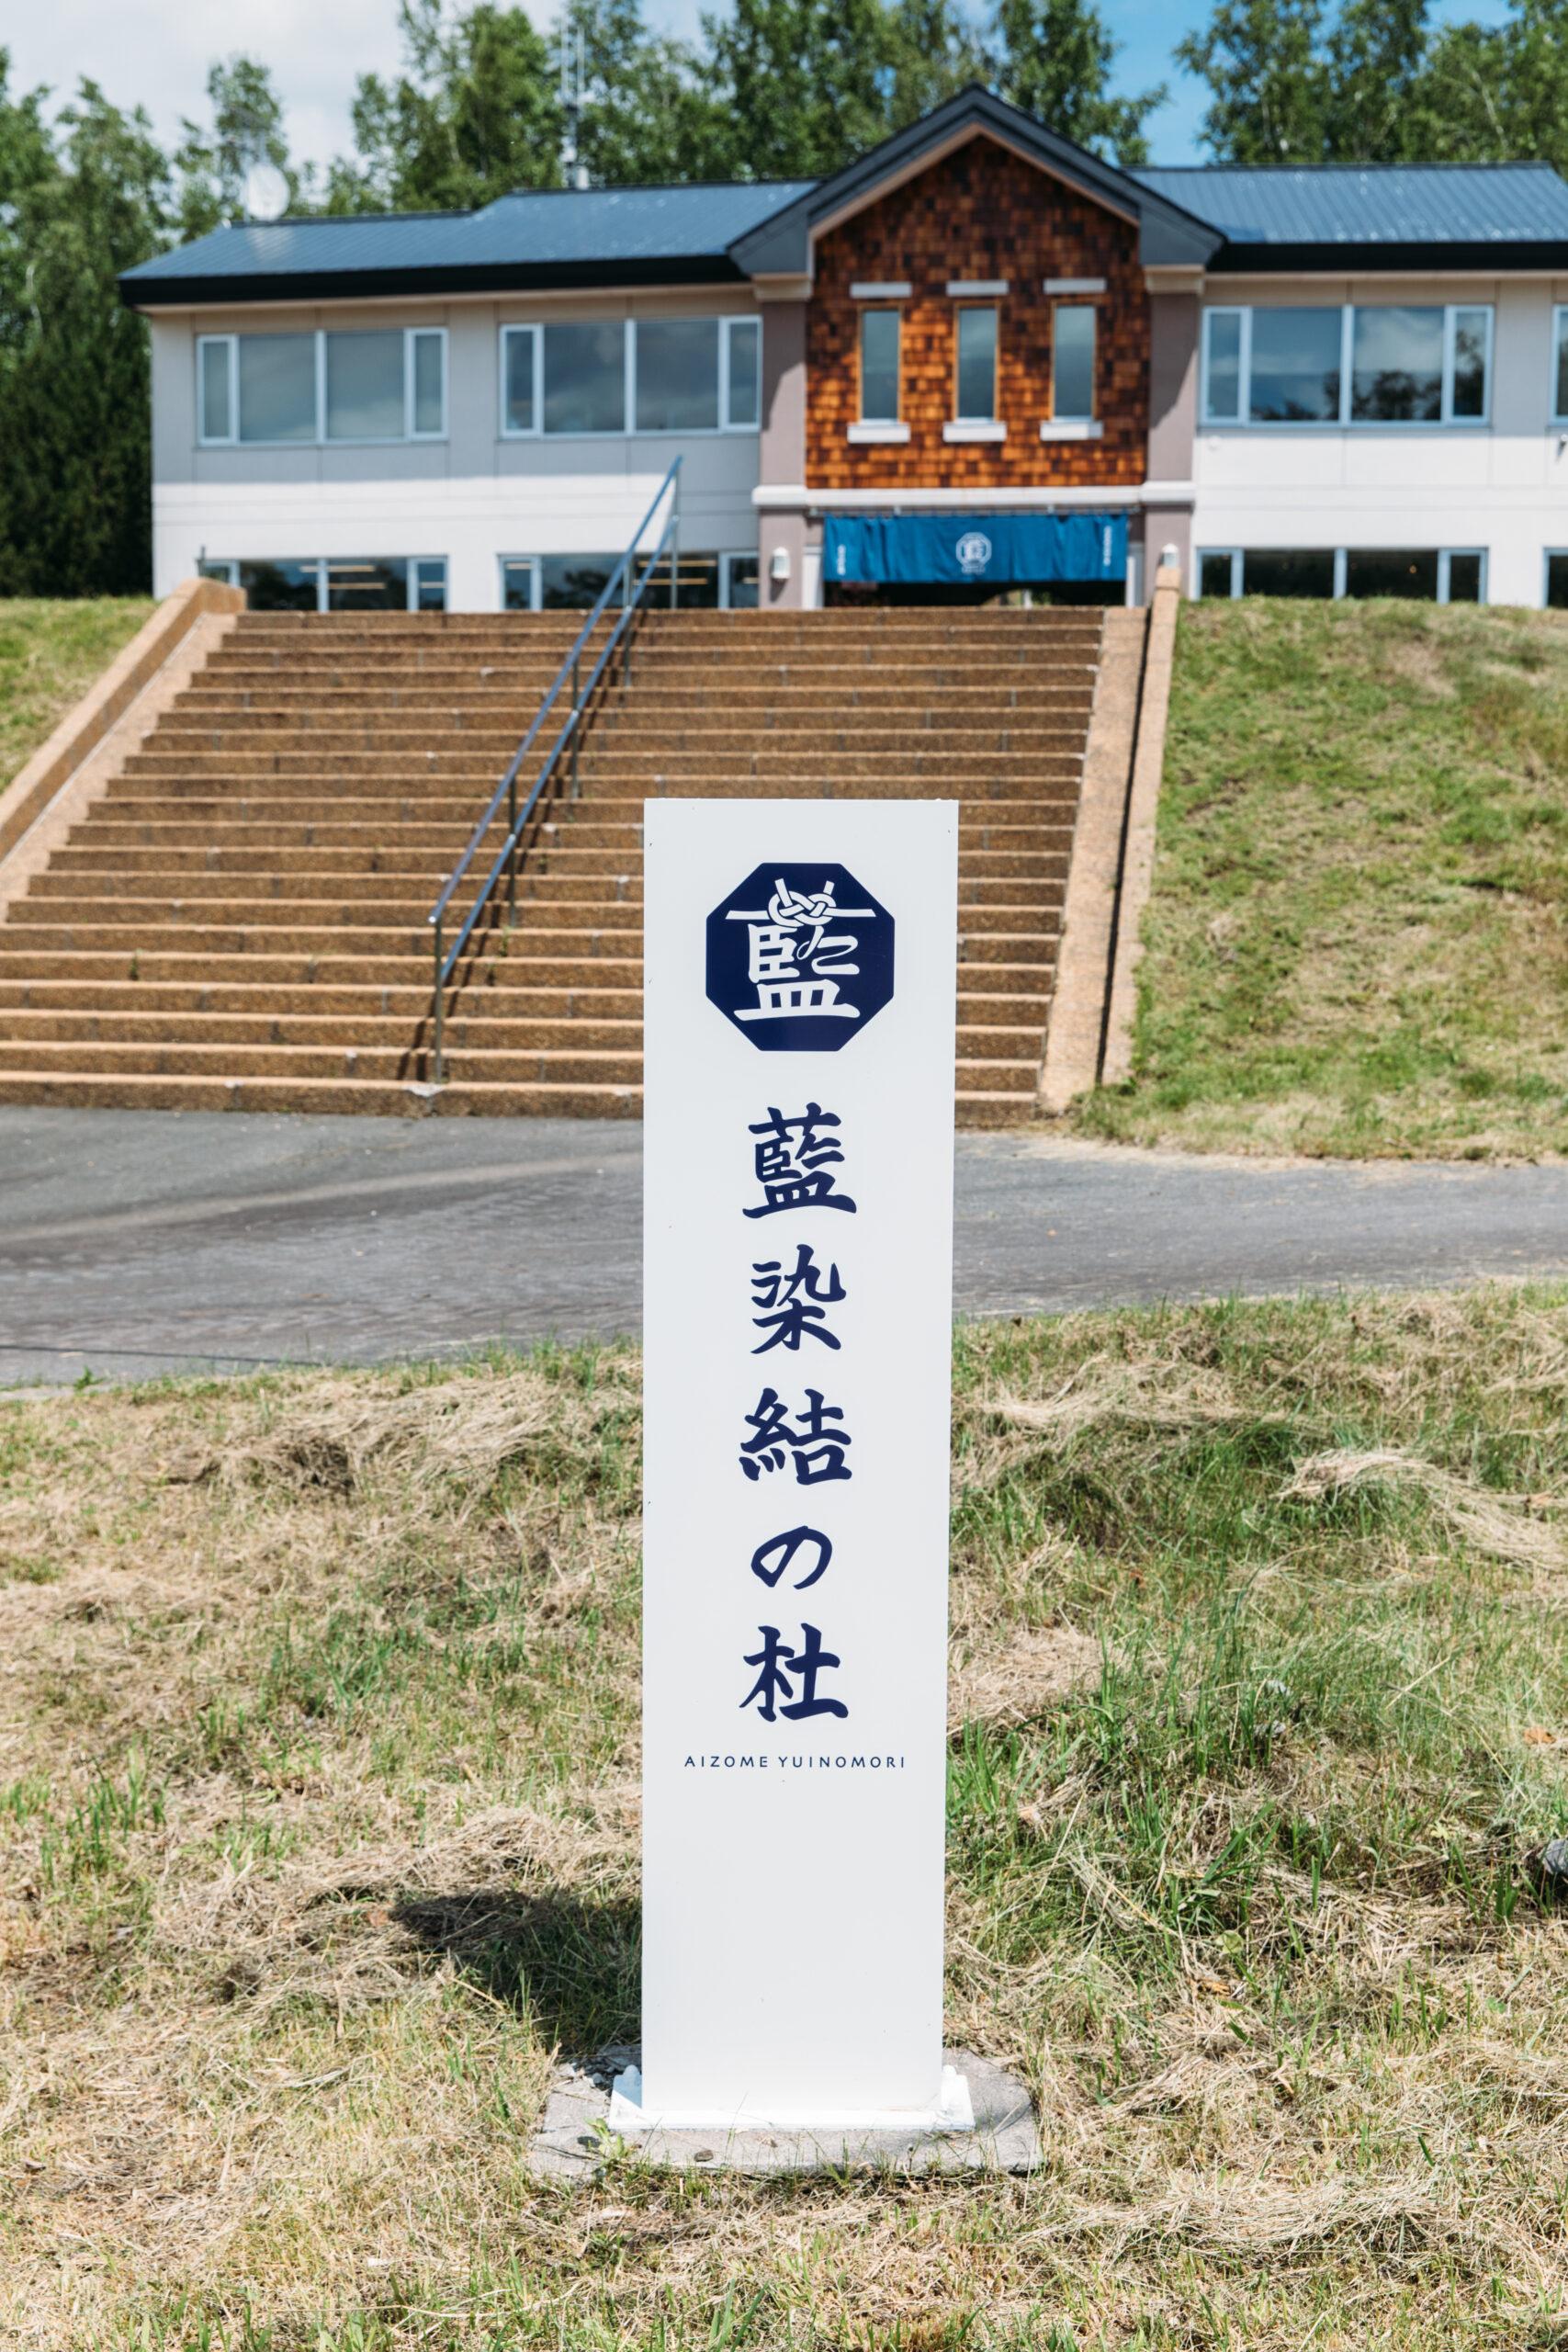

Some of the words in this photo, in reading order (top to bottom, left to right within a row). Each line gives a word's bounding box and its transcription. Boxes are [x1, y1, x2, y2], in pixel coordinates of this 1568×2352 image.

[739, 1102, 857, 1723] 藍染結の杜
[684, 1756, 768, 1769] AIZOME
[778, 1756, 905, 1769] YUINOMORI
